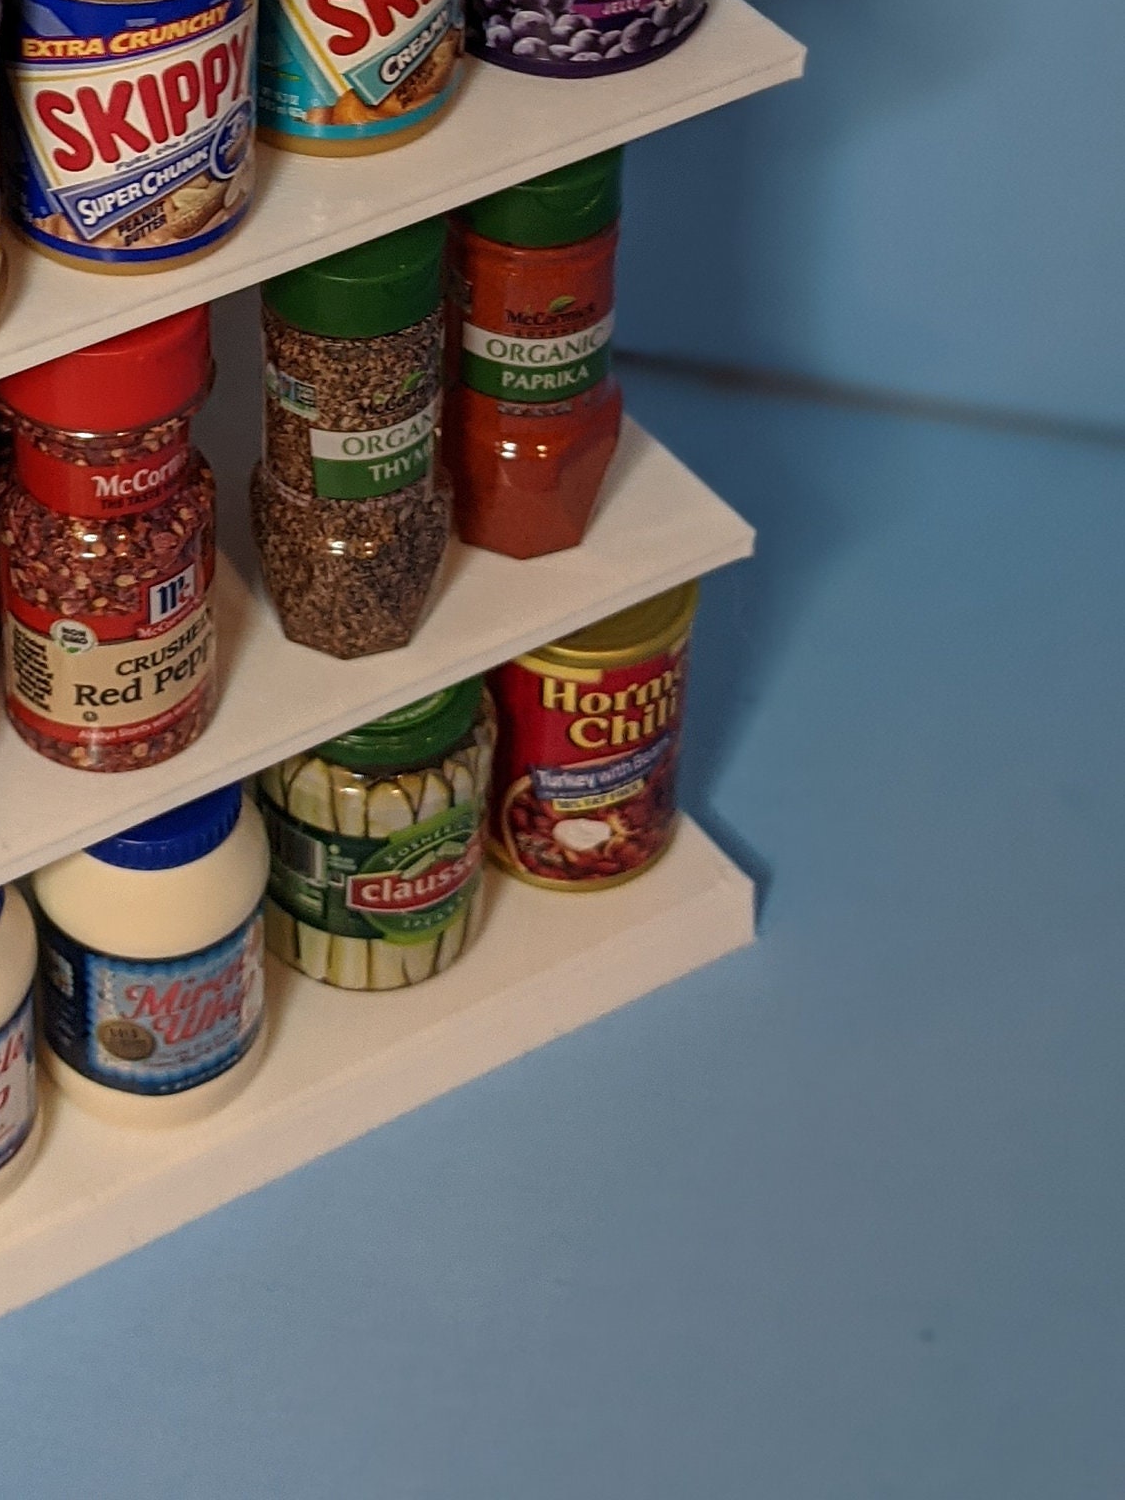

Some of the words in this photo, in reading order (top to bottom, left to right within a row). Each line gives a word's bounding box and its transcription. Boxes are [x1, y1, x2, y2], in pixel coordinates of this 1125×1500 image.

[21, 37, 106, 58] EXTRA
[110, 2, 230, 54] CRUNCHY
[36, 25, 250, 172] SKIPPY
[486, 327, 605, 365] ORGANIC
[501, 364, 590, 390] PAPRIKA
[342, 414, 432, 456] ORGAN
[368, 445, 429, 481] THYM
[73, 678, 142, 707] Red
[542, 668, 676, 715] Horm
